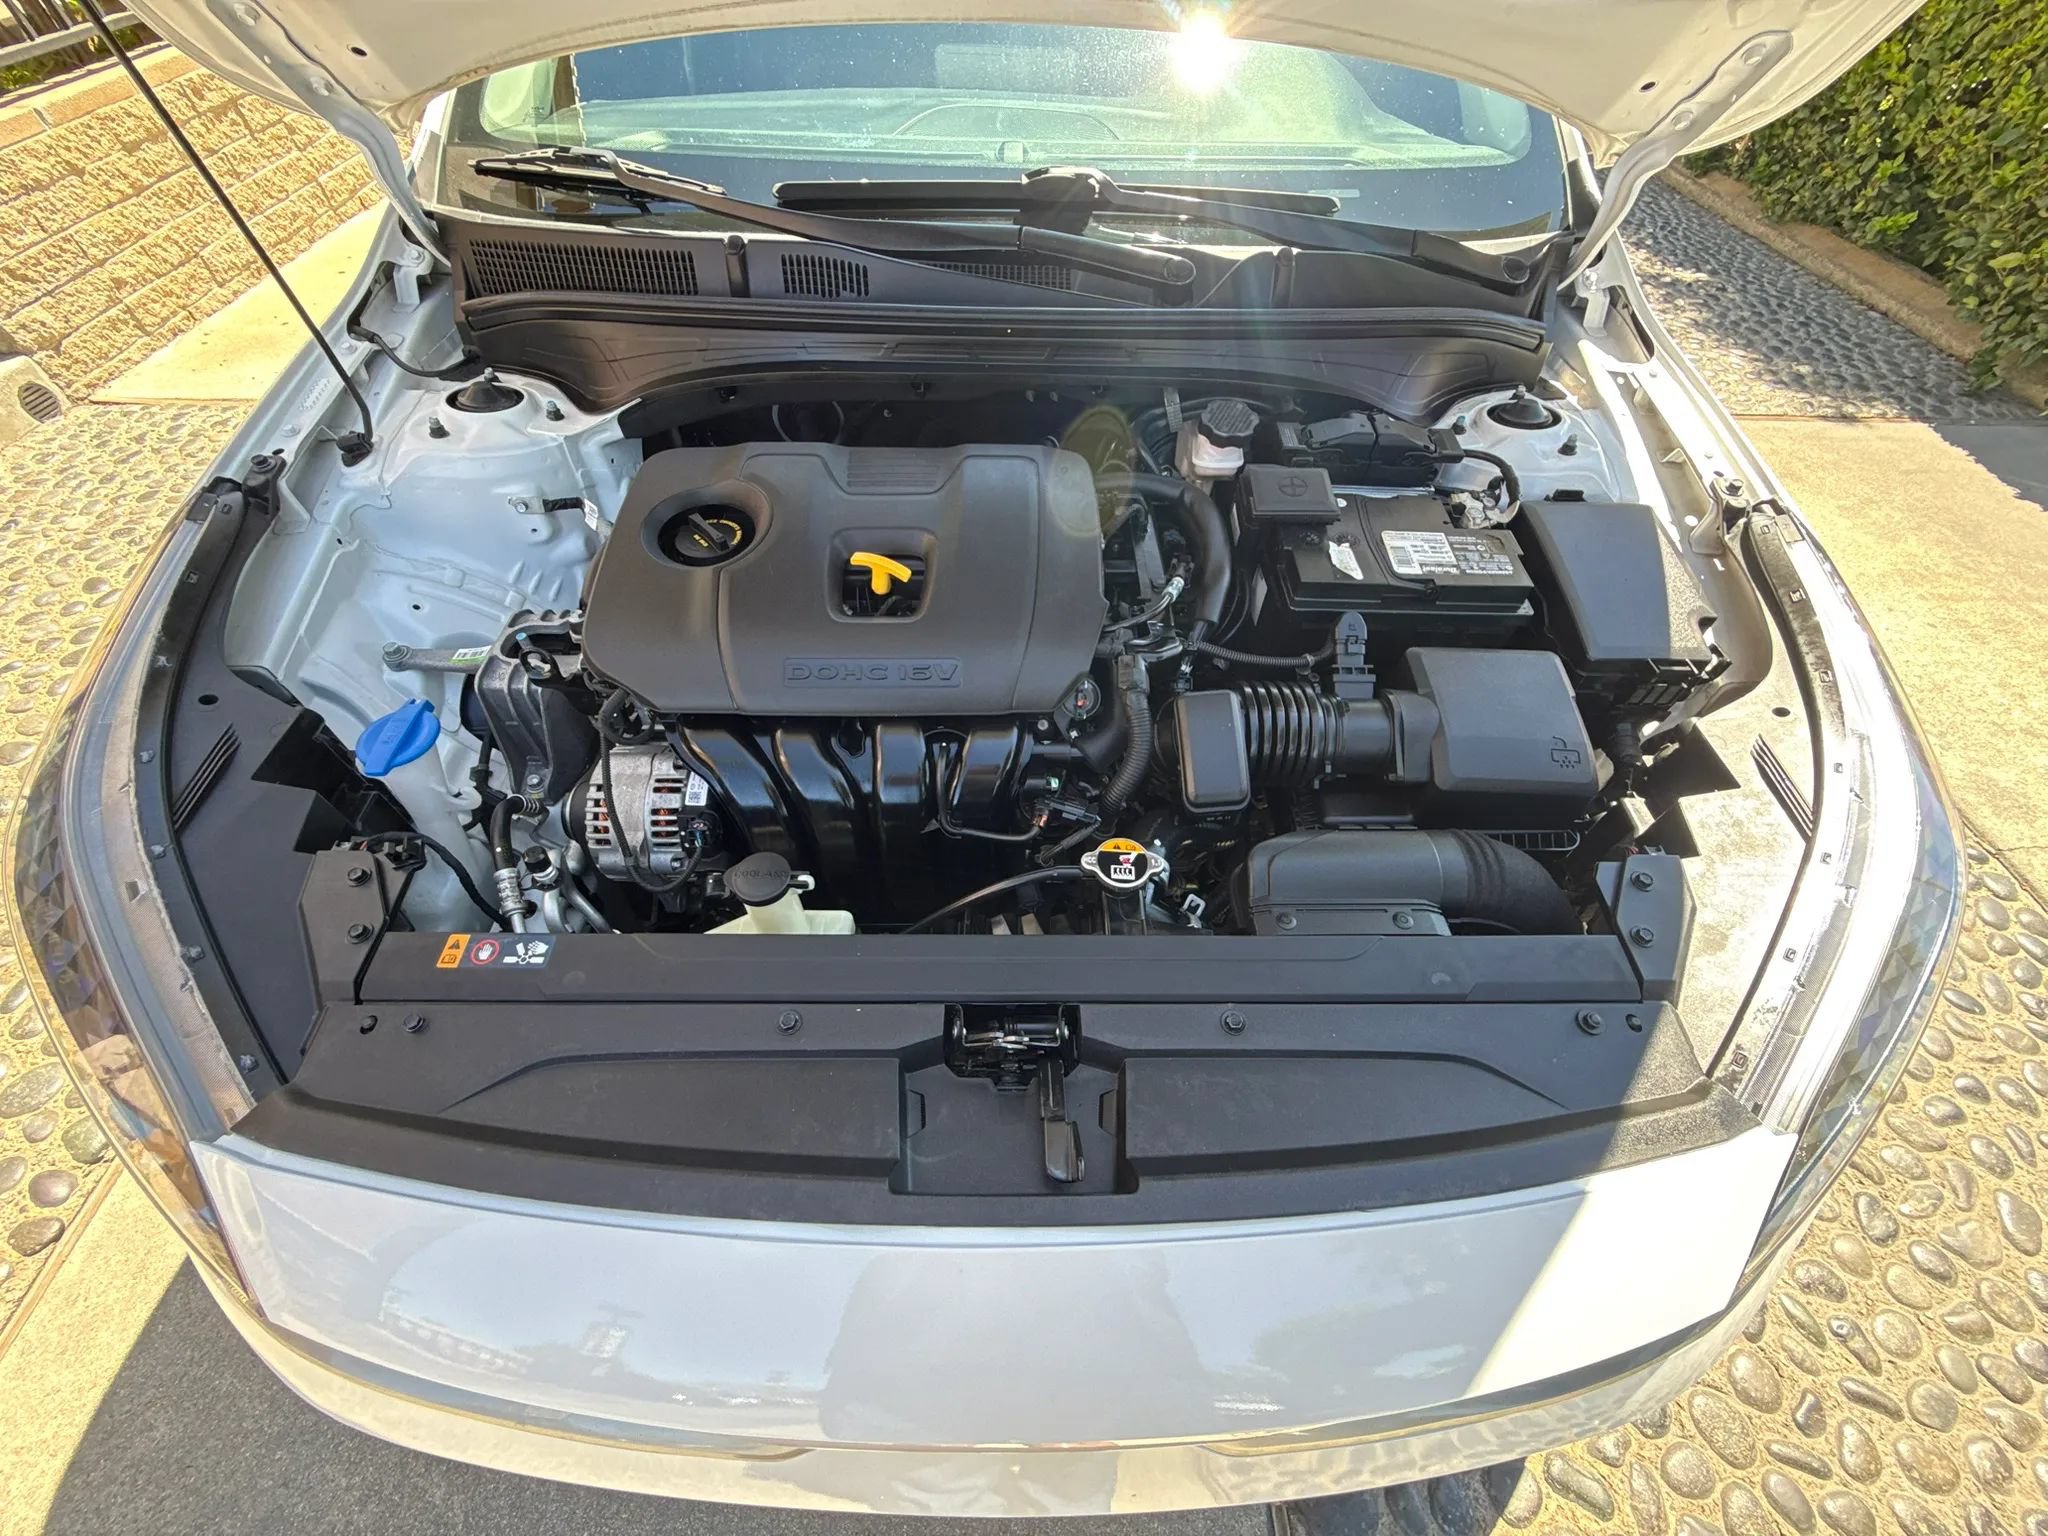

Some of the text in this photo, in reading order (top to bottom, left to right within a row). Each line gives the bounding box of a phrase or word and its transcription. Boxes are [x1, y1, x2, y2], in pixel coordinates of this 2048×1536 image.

[1422, 565, 1458, 574] Duralast
[786, 663, 959, 682] DOHC 16V
